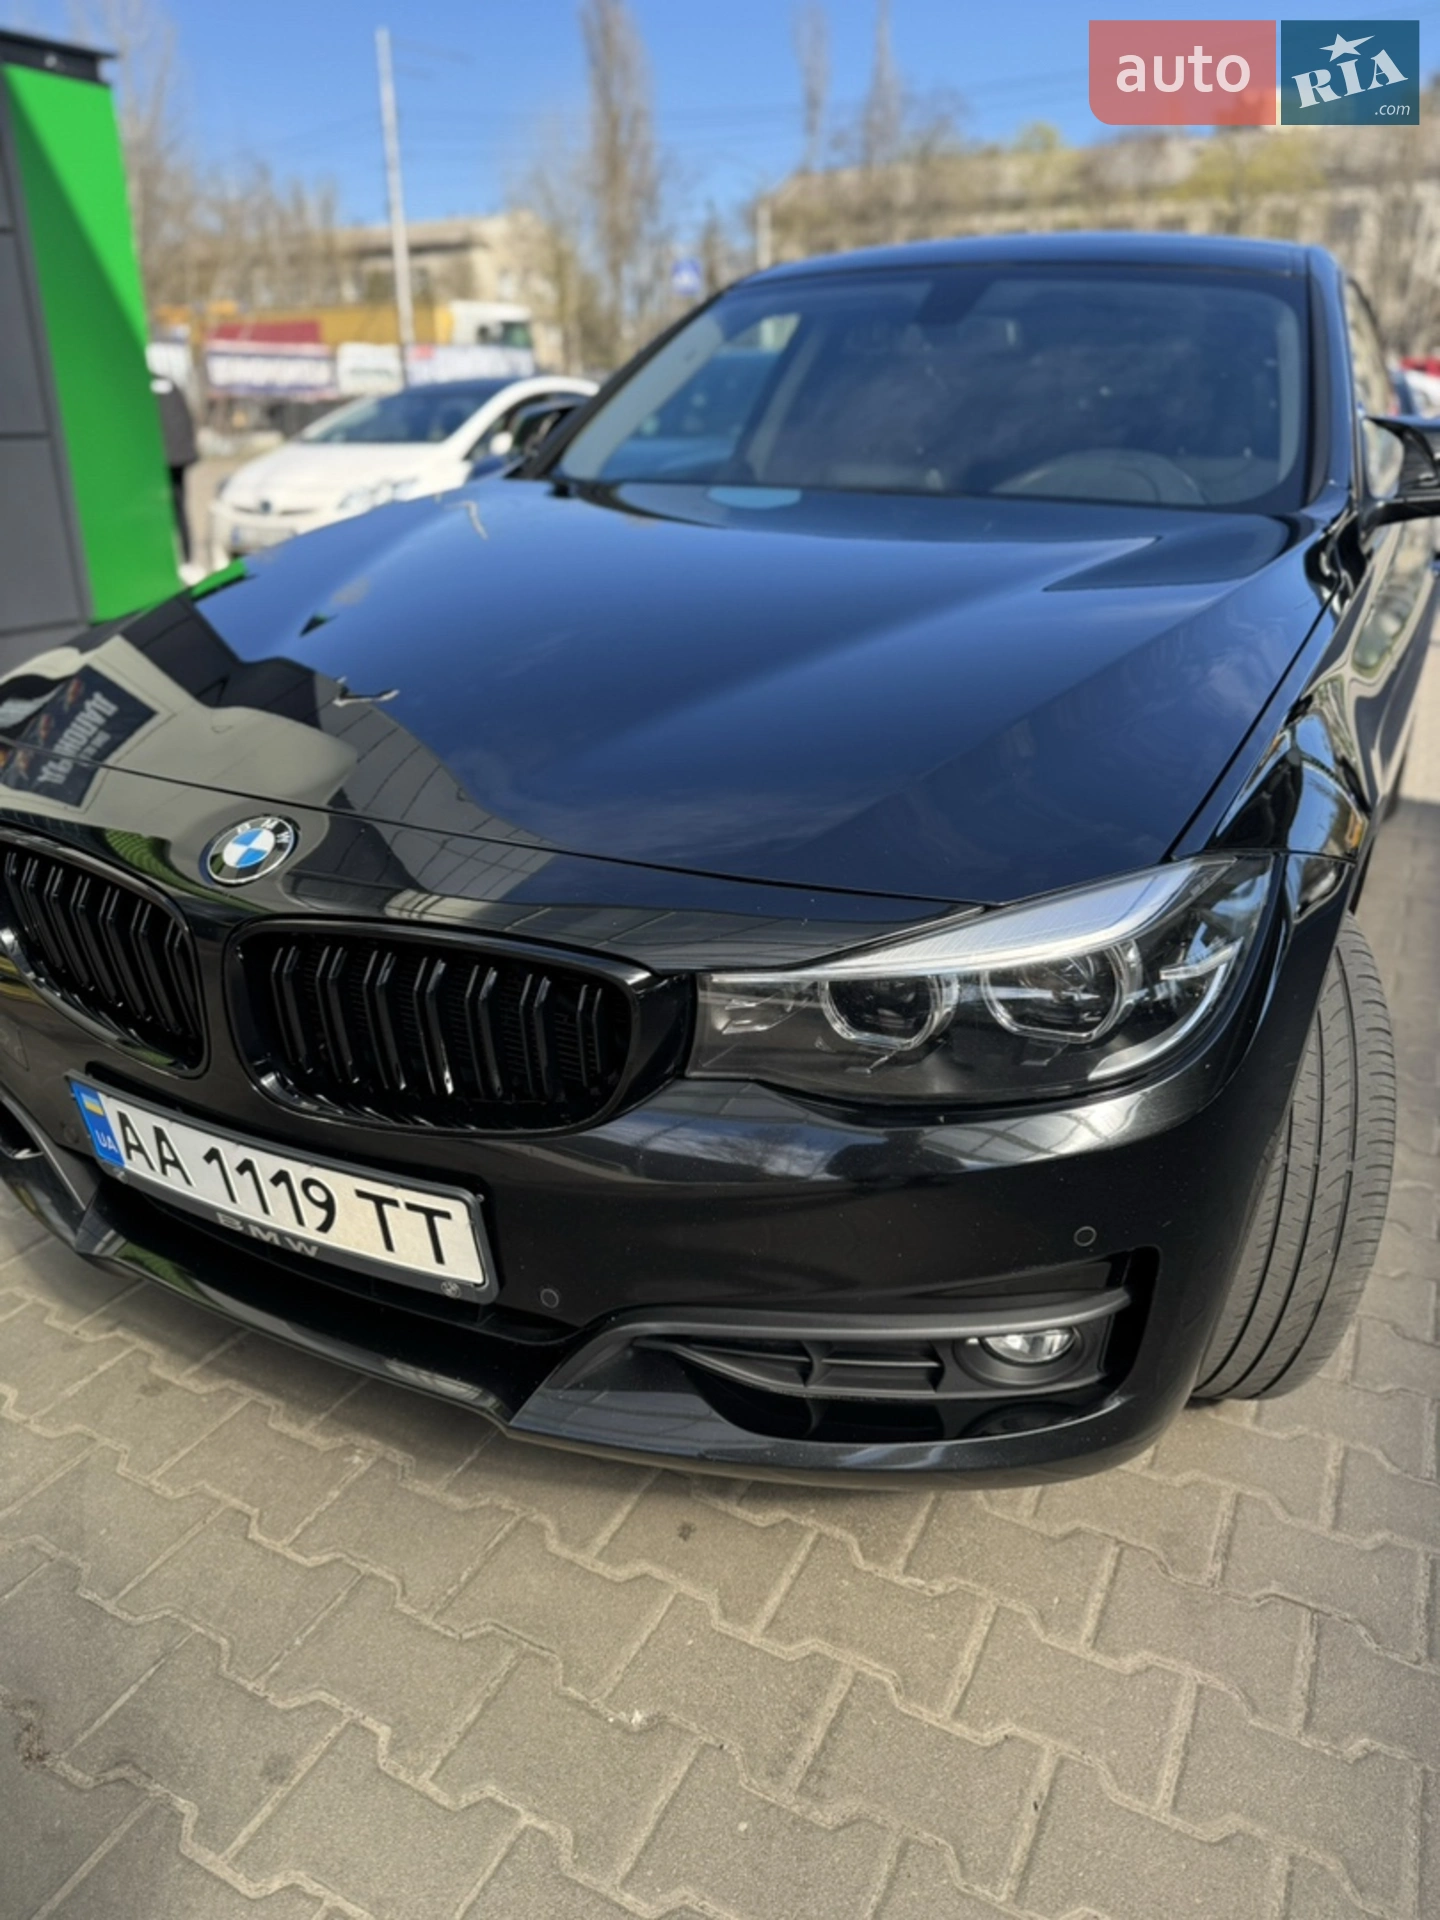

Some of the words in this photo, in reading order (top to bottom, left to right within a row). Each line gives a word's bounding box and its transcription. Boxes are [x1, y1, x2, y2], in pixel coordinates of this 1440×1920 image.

[236, 818, 290, 845] BMW
[95, 1130, 119, 1154] UA
[117, 1110, 196, 1188] AA
[203, 1146, 337, 1233] 1119
[355, 1189, 452, 1265] TT
[216, 1211, 319, 1257] BMW
